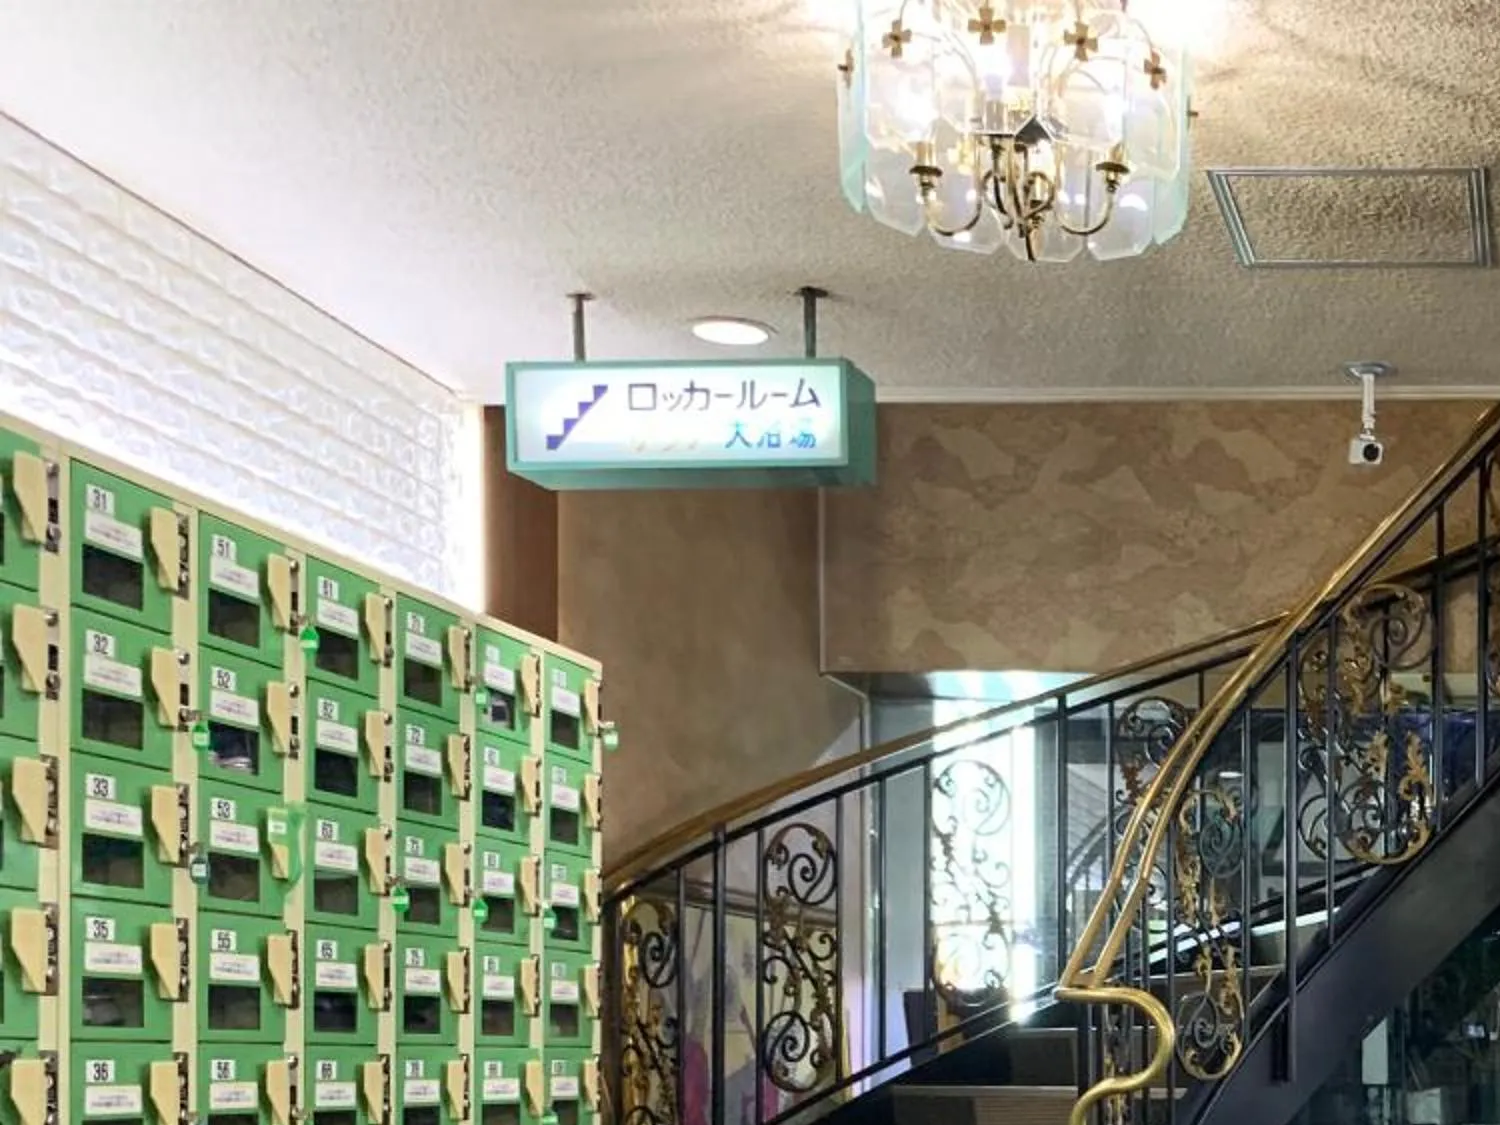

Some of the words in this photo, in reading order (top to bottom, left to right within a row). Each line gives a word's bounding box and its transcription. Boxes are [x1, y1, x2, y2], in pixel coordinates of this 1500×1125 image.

[627, 377, 822, 411] ロッカールーム
[92, 488, 107, 511] 31
[216, 538, 230, 558] 51
[93, 633, 109, 655] 32
[216, 669, 230, 689] 52
[92, 776, 109, 798] 33
[217, 799, 230, 819] 53
[93, 919, 109, 940] 35
[92, 1061, 109, 1081] 36
